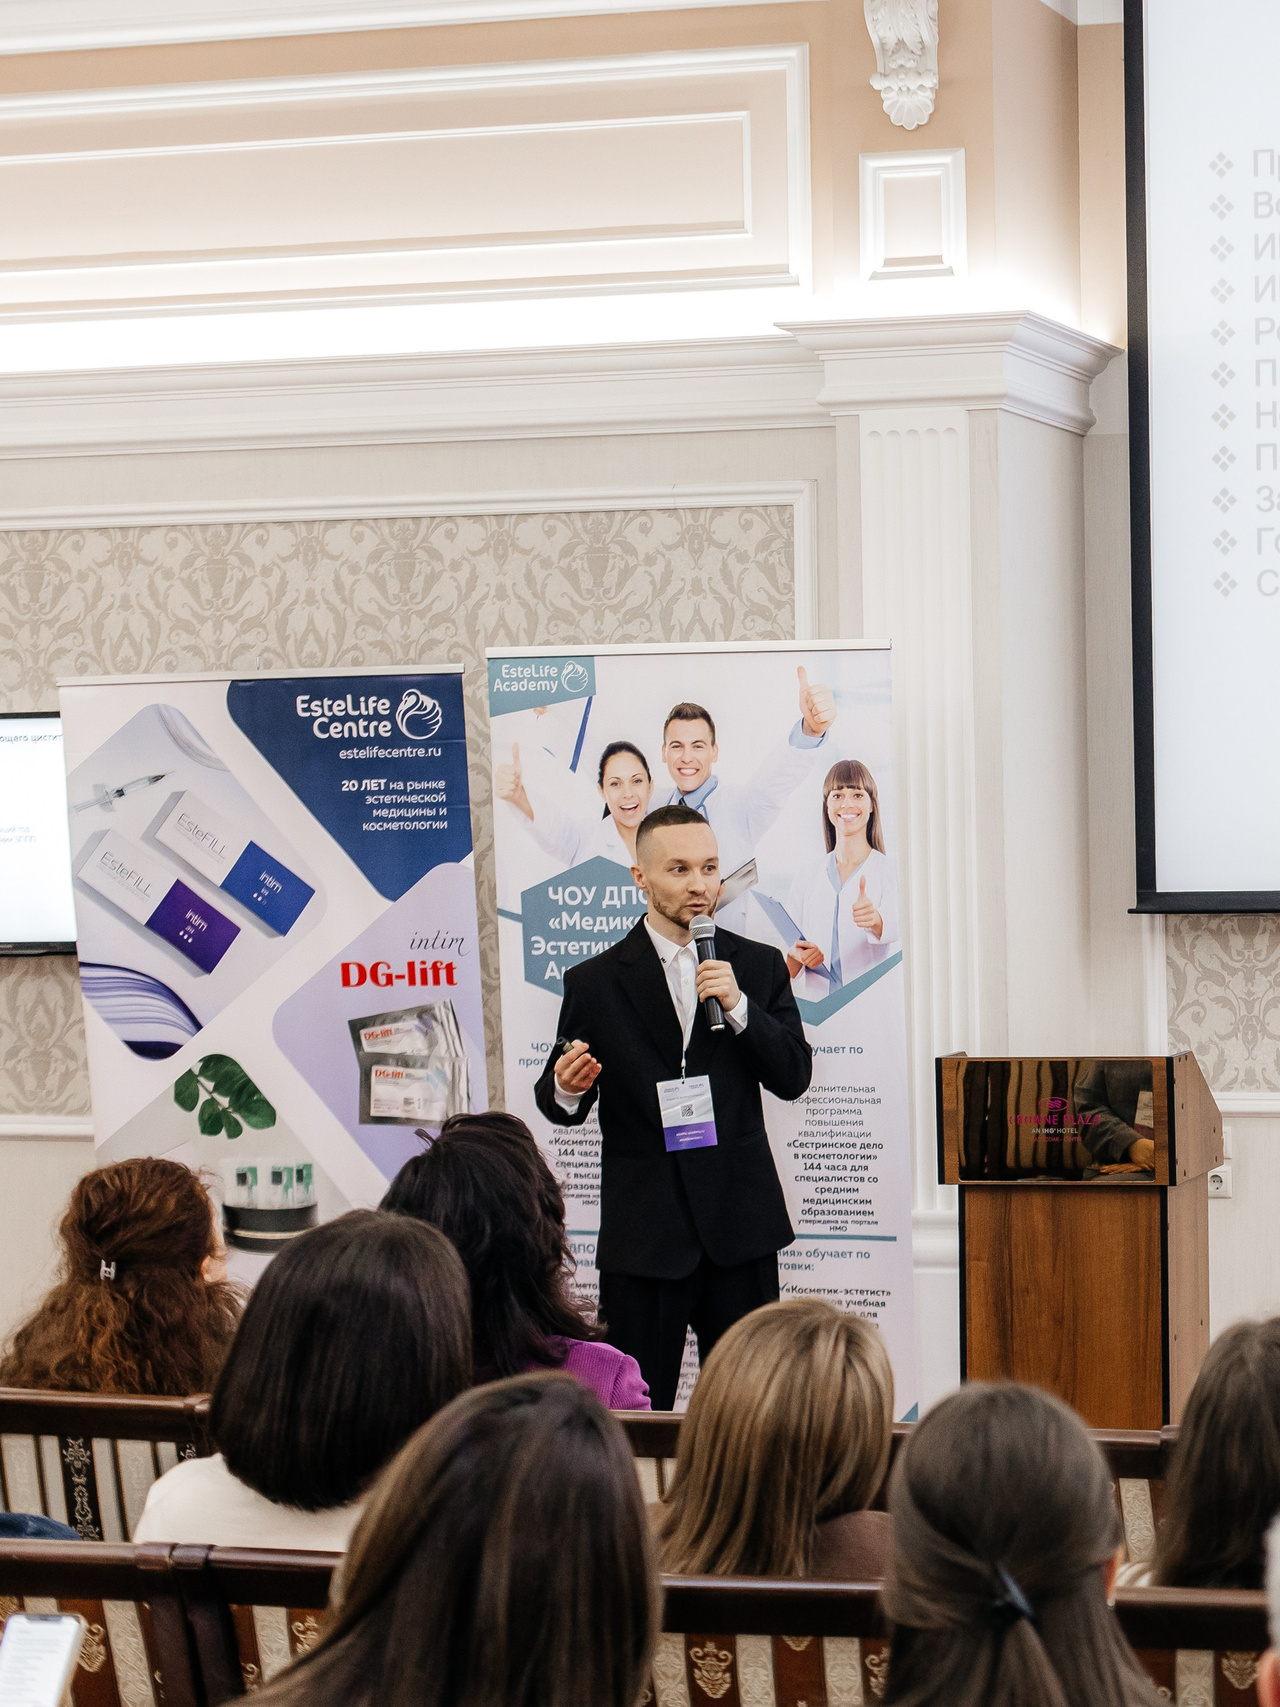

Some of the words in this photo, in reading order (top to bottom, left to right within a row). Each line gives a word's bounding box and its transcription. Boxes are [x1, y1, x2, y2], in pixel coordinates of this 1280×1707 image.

[501, 664, 558, 678] EsteLife
[493, 679, 558, 693] Academy
[296, 694, 390, 717] EsteLife
[313, 717, 392, 739] Centre
[339, 746, 441, 759] estelifecentre.ru
[341, 780, 358, 791] 20
[360, 779, 387, 790] ЛЕТ
[389, 780, 404, 790] на
[407, 780, 445, 792] рынке
[365, 792, 446, 804] эстетической
[373, 807, 436, 818] медицины
[439, 807, 447, 815] и
[362, 820, 448, 831] косметологии
[548, 886, 597, 906] ЧОУ
[409, 930, 471, 956] intim
[341, 960, 458, 988] DG-lift
[531, 1043, 553, 1053] ЧО
[849, 1046, 863, 1054] по
[806, 1108, 862, 1116] программа
[805, 1119, 864, 1127] повышения
[1009, 1114, 1059, 1125] CROWNE
[1063, 1114, 1101, 1125] PLAZA
[553, 1128, 601, 1137] квалифик
[798, 1129, 872, 1139] квалификации
[548, 1137, 602, 1146] «Косметол
[787, 1139, 857, 1150] «Сестринское
[859, 1142, 884, 1150] дело
[558, 1149, 575, 1157] 144
[803, 1163, 822, 1171] 144
[850, 1164, 869, 1172] для
[794, 1175, 865, 1183] специалистов
[815, 1187, 859, 1195] средним
[801, 1207, 874, 1217] образованием
[805, 1248, 852, 1261] обучает
[856, 1251, 871, 1259] по
[785, 1285, 891, 1297] «Косметик-эстетист»
[845, 1299, 886, 1308] учебная
